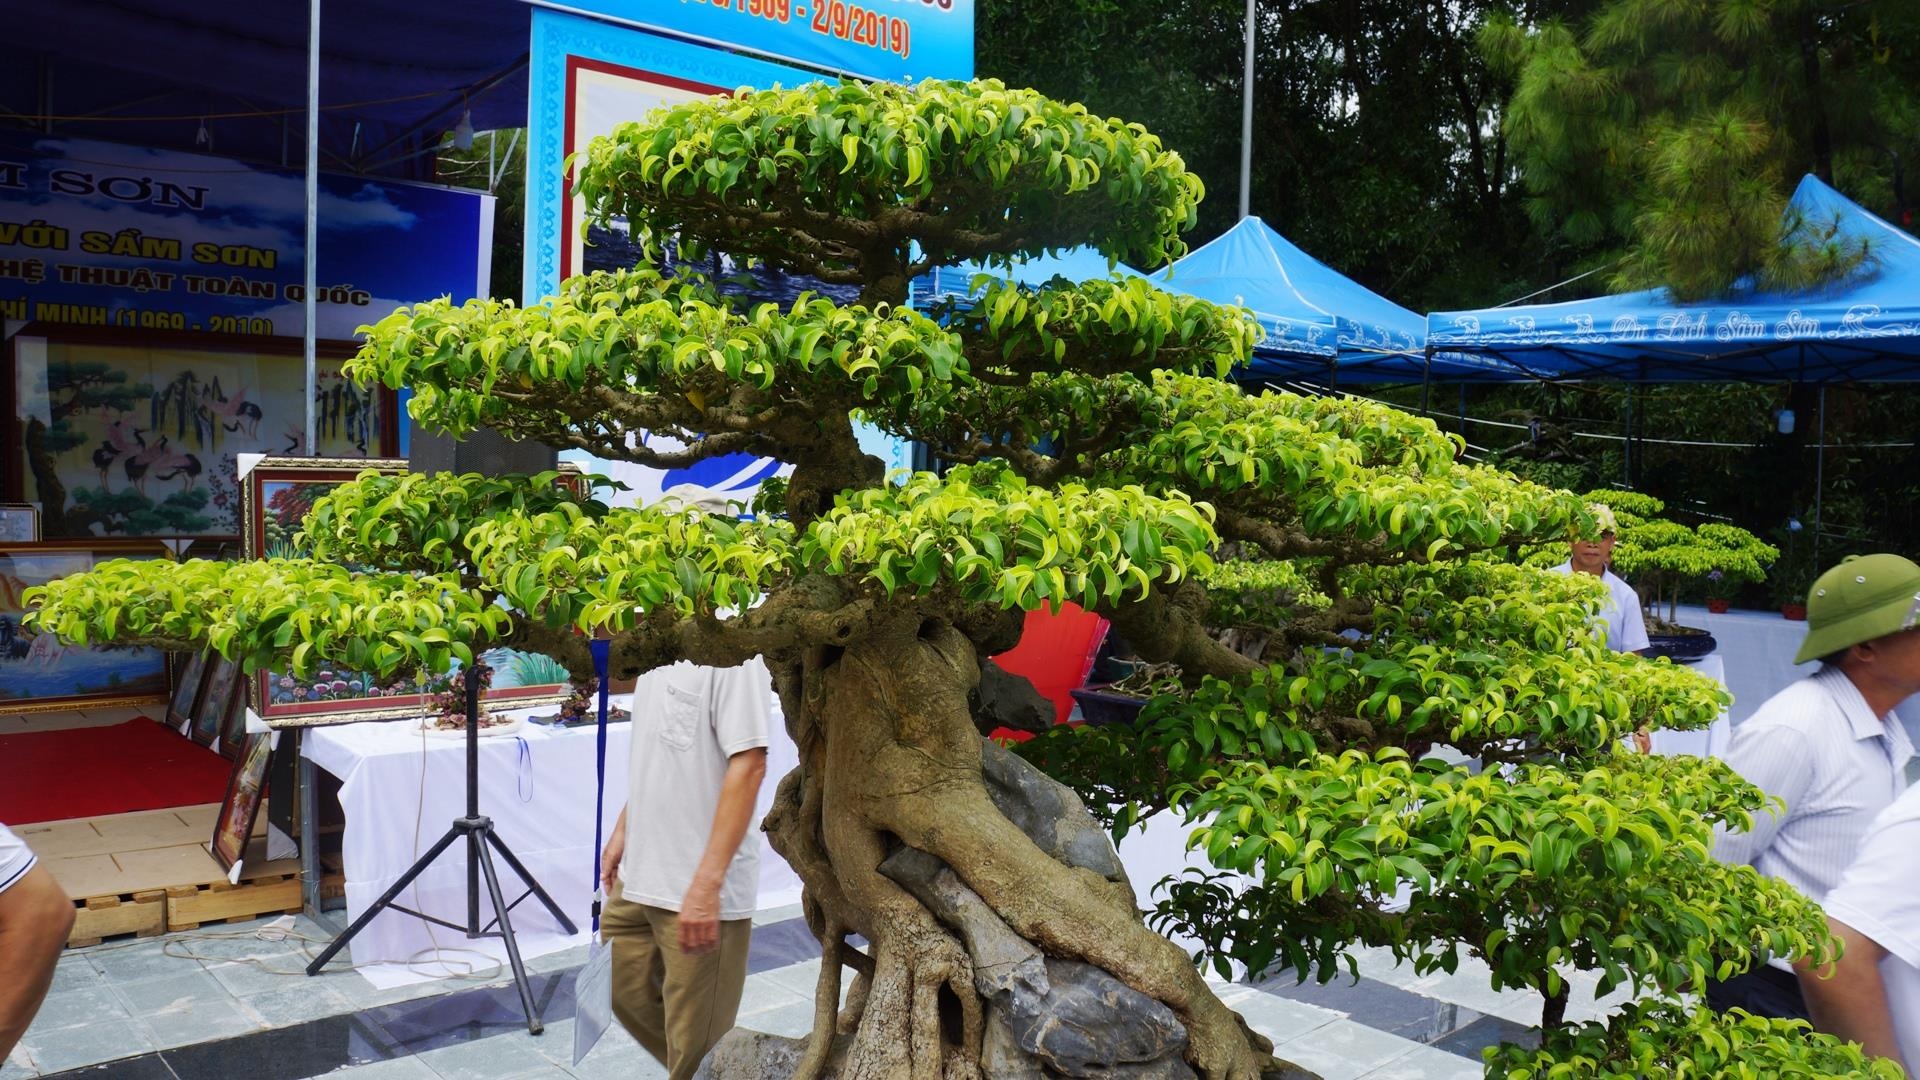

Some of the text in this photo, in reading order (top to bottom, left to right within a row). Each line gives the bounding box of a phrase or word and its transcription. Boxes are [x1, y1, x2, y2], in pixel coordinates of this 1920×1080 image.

[811, 0, 910, 58] 2/9/2019)
[51, 170, 209, 209] SƠN
[81, 229, 181, 261] SẦM
[192, 243, 276, 270] SƠN
[57, 264, 176, 292] THUẬT
[184, 276, 275, 299] TOÀN
[36, 303, 107, 325] MINH
